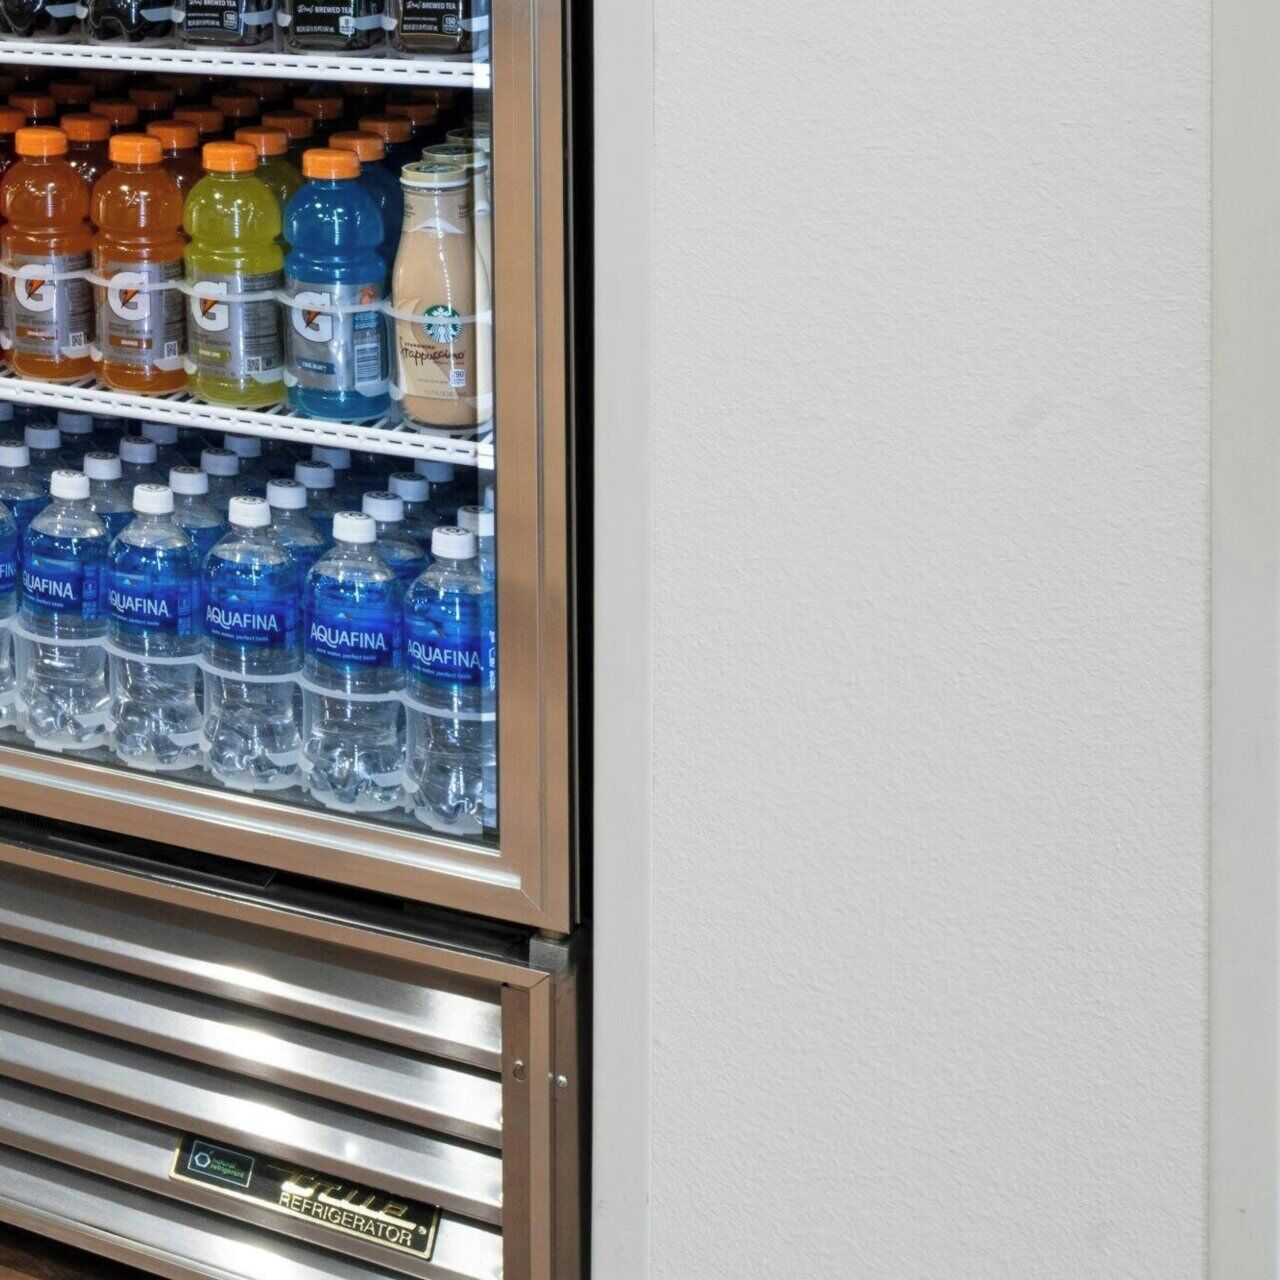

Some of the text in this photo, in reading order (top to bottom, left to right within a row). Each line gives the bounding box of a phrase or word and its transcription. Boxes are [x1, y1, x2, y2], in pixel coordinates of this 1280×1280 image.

[204, 0, 237, 7] BREWED TEA
[314, 6, 352, 14] BREWED TEA
[421, 2, 456, 10] BREWED TEA
[192, 281, 230, 332] G
[292, 291, 333, 343] G
[206, 604, 278, 632] AQUAFINA
[310, 622, 386, 651] AQUAFINA
[407, 638, 482, 669] AQUAFINA
[278, 1191, 413, 1246] REFRIGERATOR
